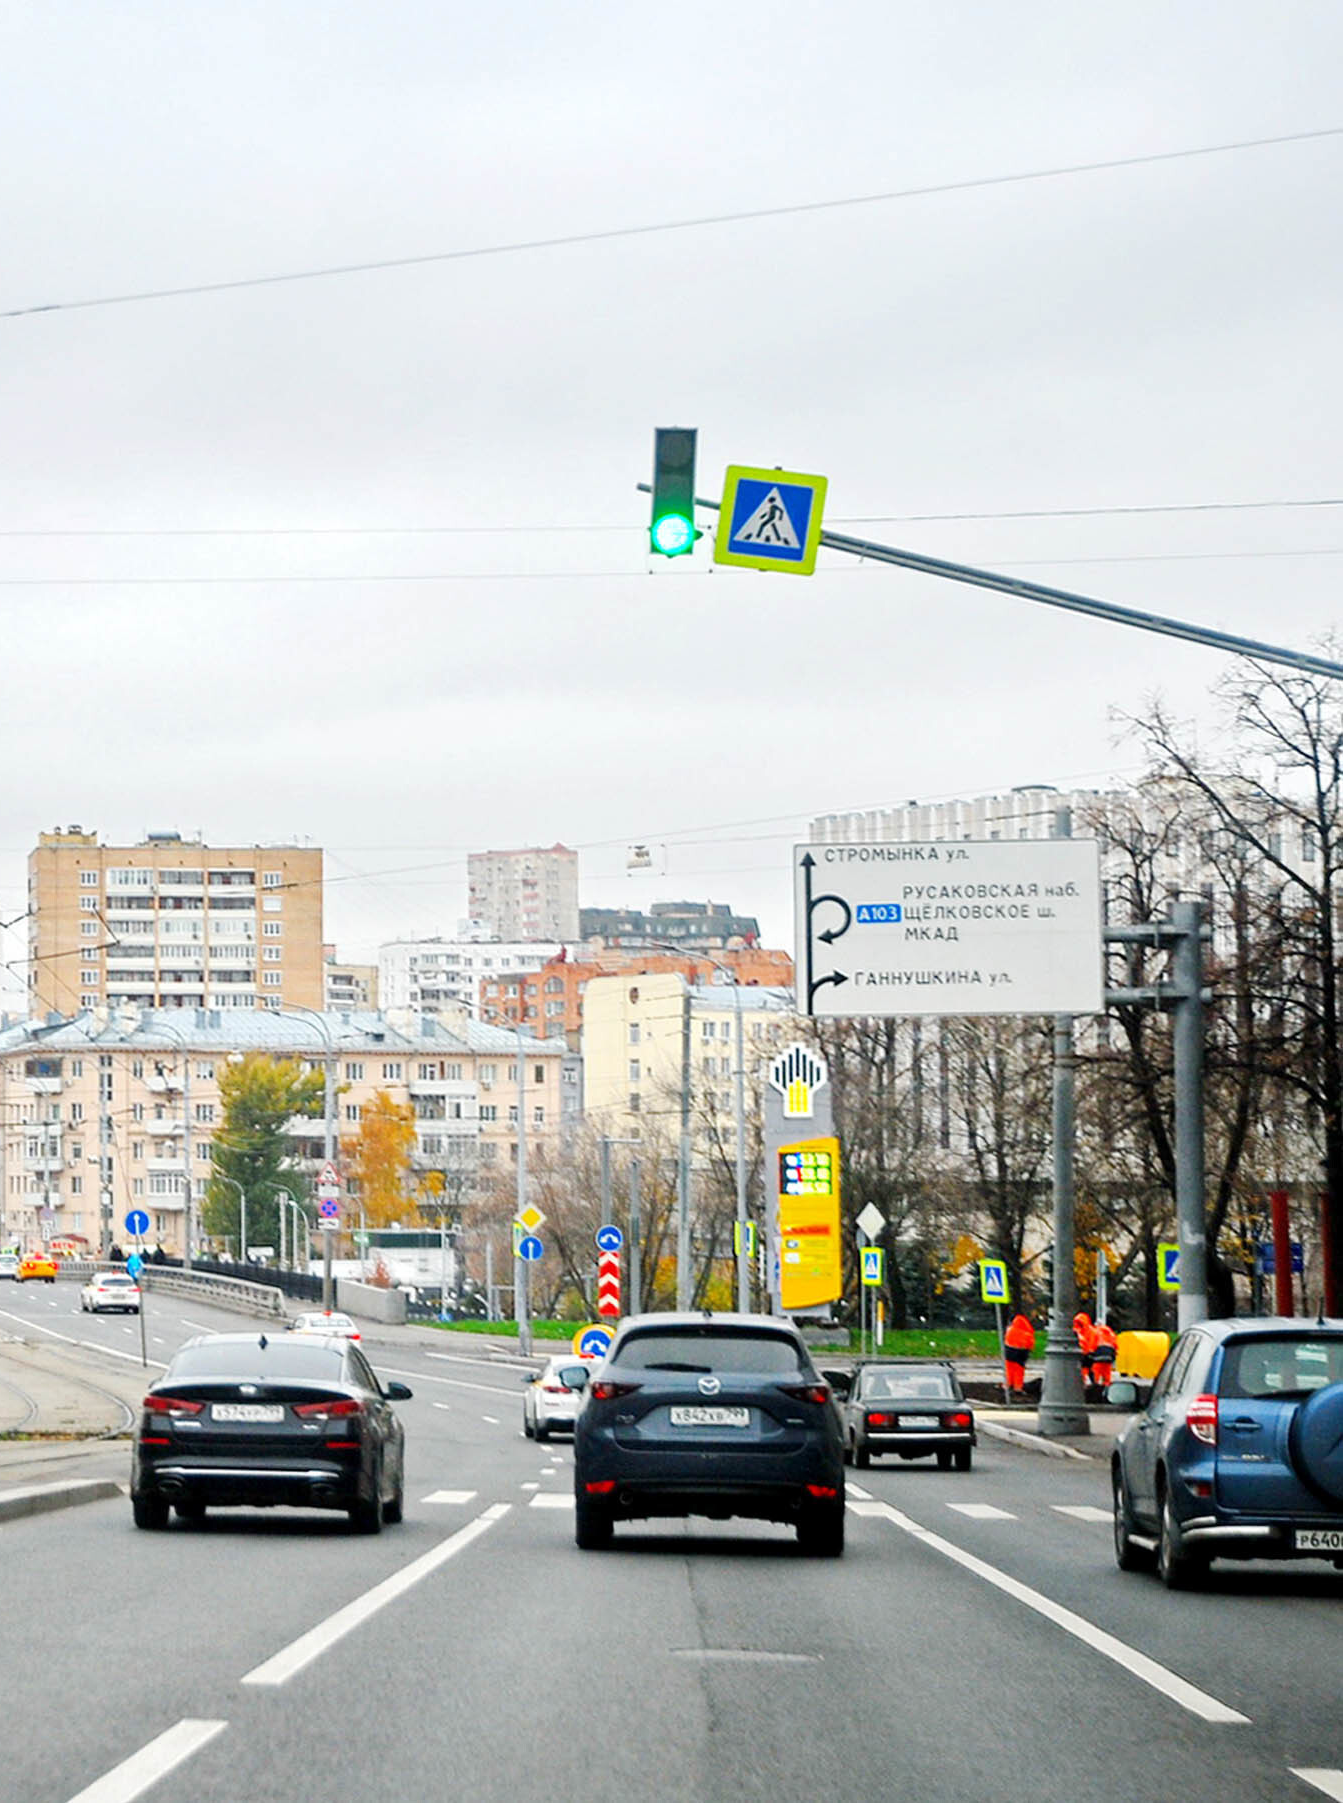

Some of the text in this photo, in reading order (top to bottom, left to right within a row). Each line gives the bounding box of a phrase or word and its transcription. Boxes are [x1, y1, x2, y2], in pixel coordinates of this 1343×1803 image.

[824, 847, 970, 864] СТРОМЫНКА ул.
[902, 882, 1080, 900] РУСАКОВСКАЯ наб.
[904, 904, 1056, 921] ЩЁЛКОВСКОЕ ш.
[905, 926, 959, 941] МКАД
[855, 970, 1013, 987] ГАННУШКИНА ул.
